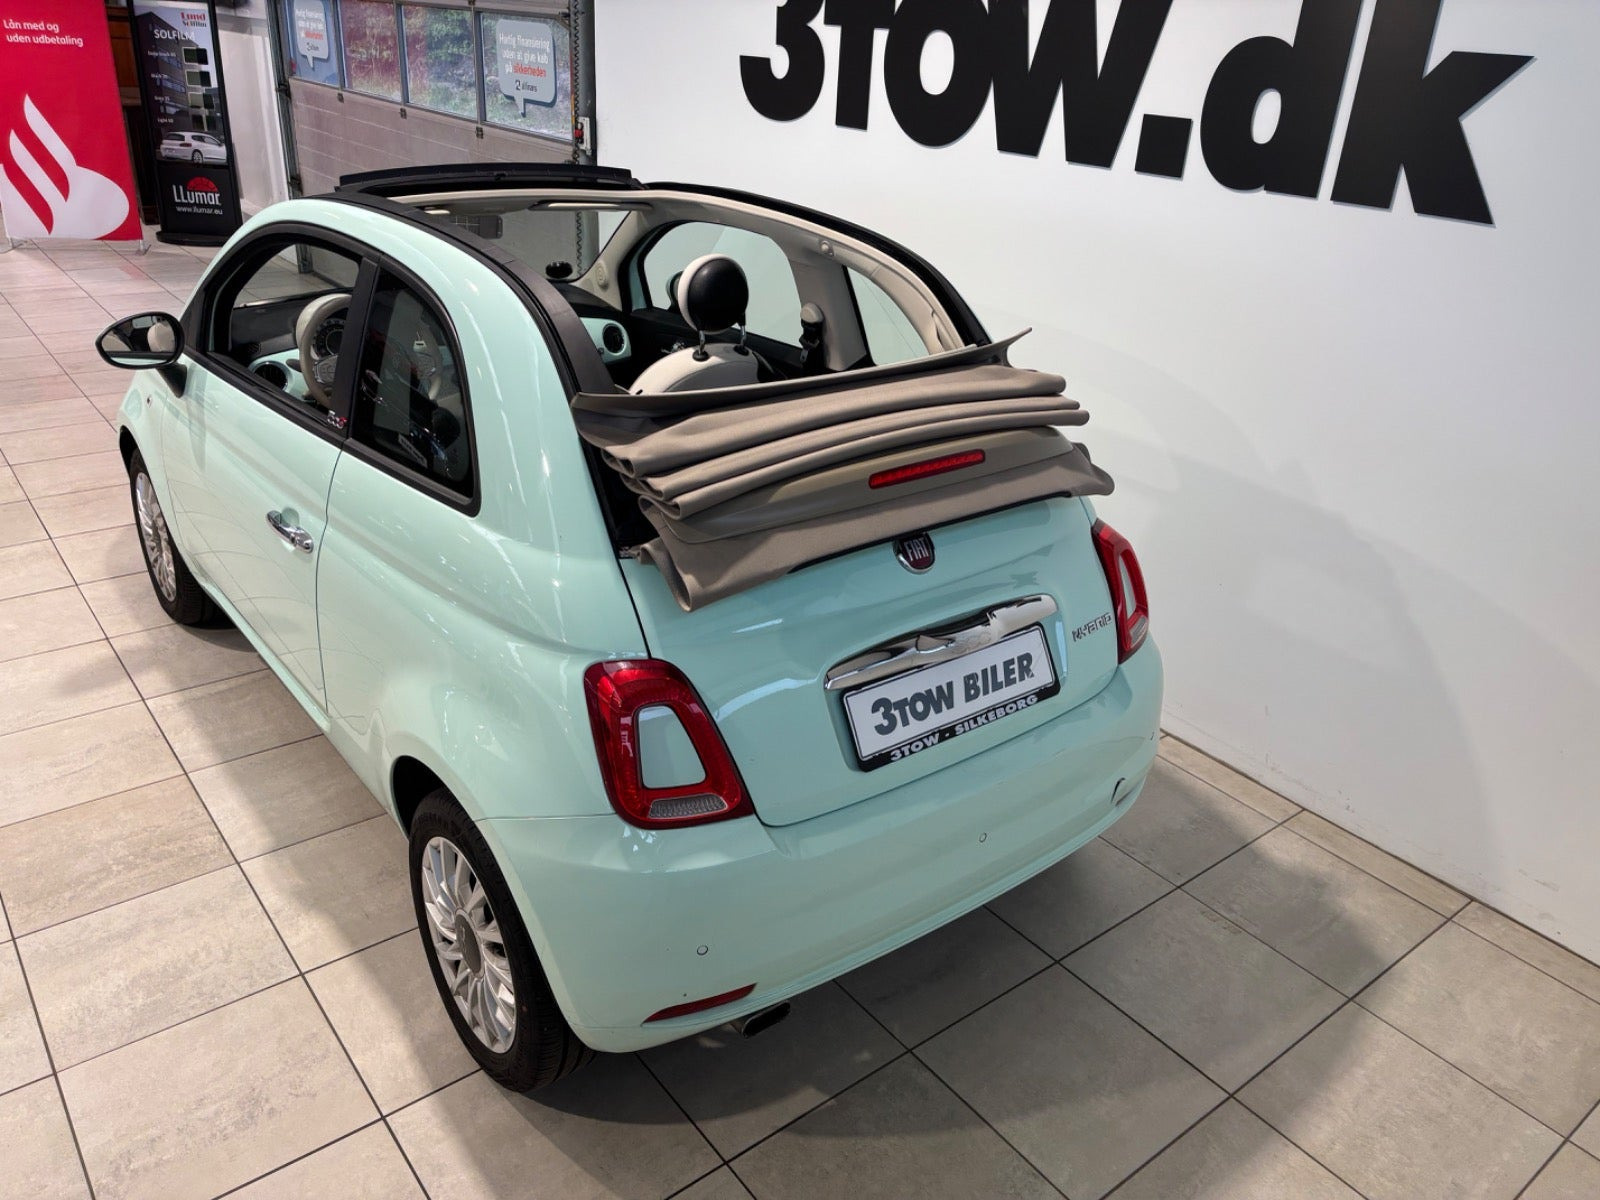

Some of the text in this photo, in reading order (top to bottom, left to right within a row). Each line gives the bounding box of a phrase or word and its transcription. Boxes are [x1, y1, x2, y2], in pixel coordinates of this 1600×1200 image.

[3, 18, 60, 34] Lån med og
[153, 29, 196, 41] SOLFILM
[6, 33, 84, 48] uden udbetaling
[903, 537, 929, 561] FIAT
[871, 652, 1035, 736] 3TOW BILER
[890, 732, 940, 762] 3TOW
[954, 694, 1039, 736] SILKEBORG
